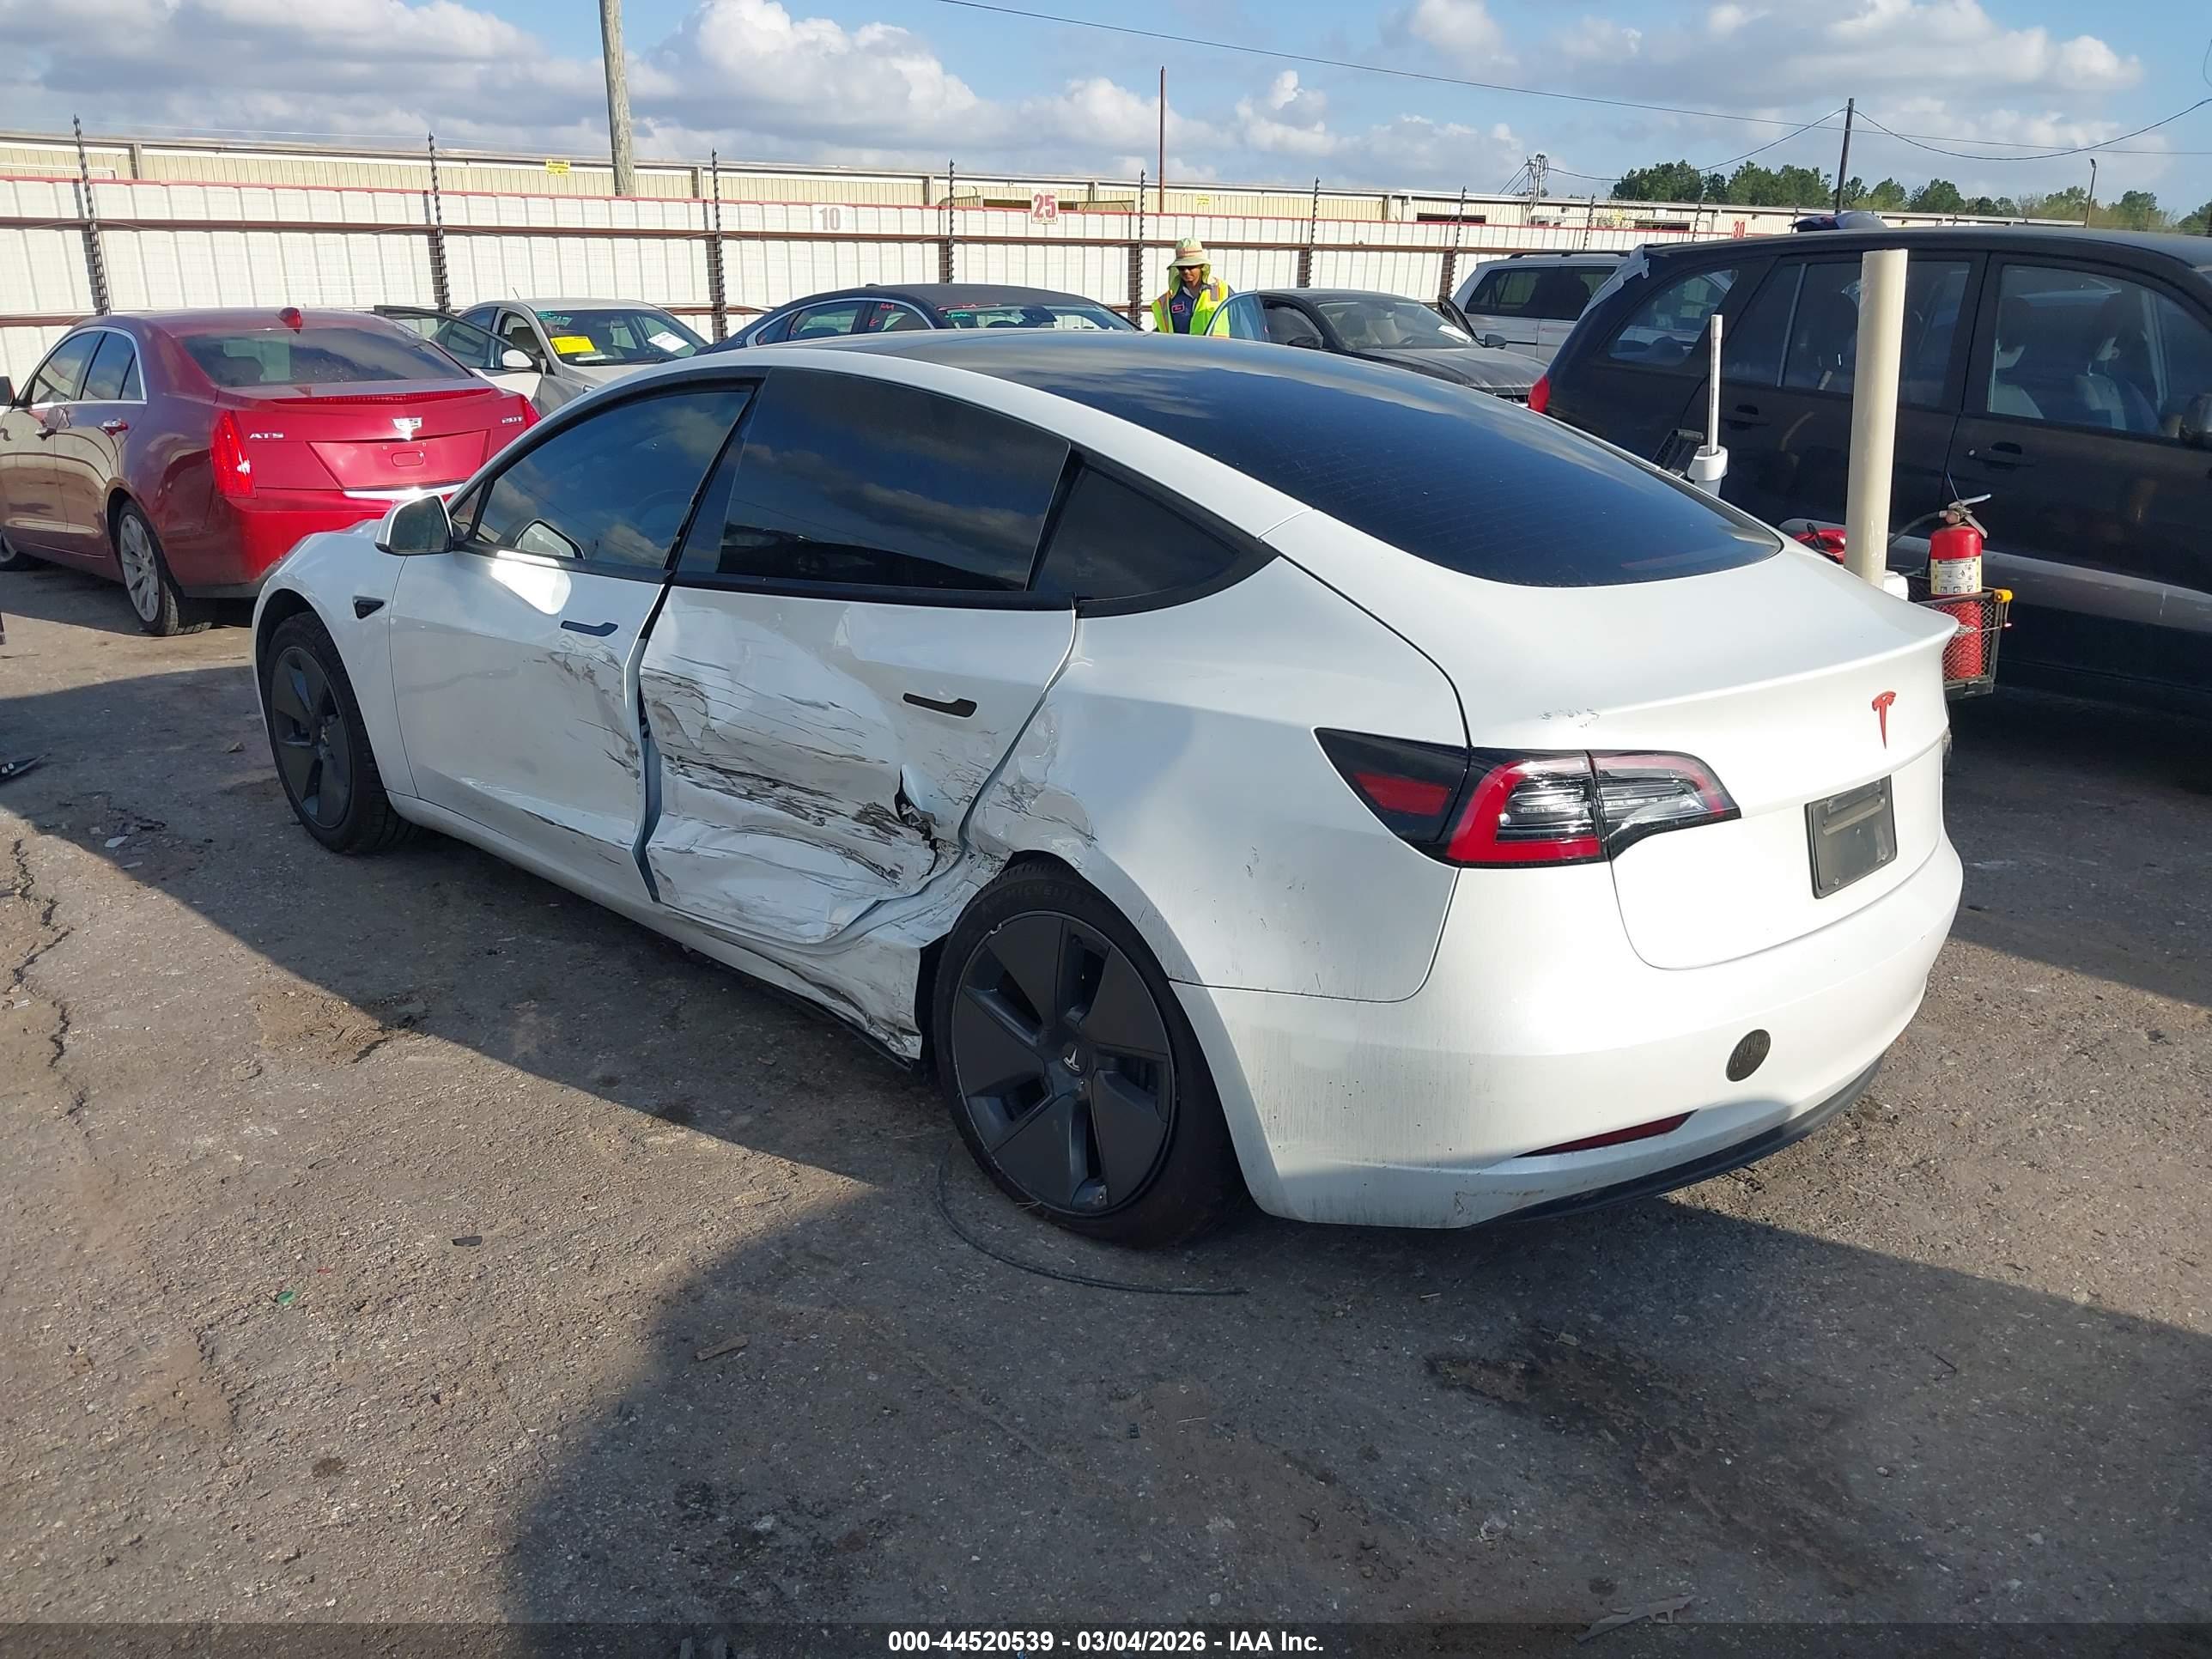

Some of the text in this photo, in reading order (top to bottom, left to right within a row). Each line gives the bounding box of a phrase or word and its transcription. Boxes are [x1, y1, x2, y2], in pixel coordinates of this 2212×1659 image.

[1033, 193, 1056, 218] 25
[818, 207, 841, 231] 10
[1733, 220, 1746, 238] 30
